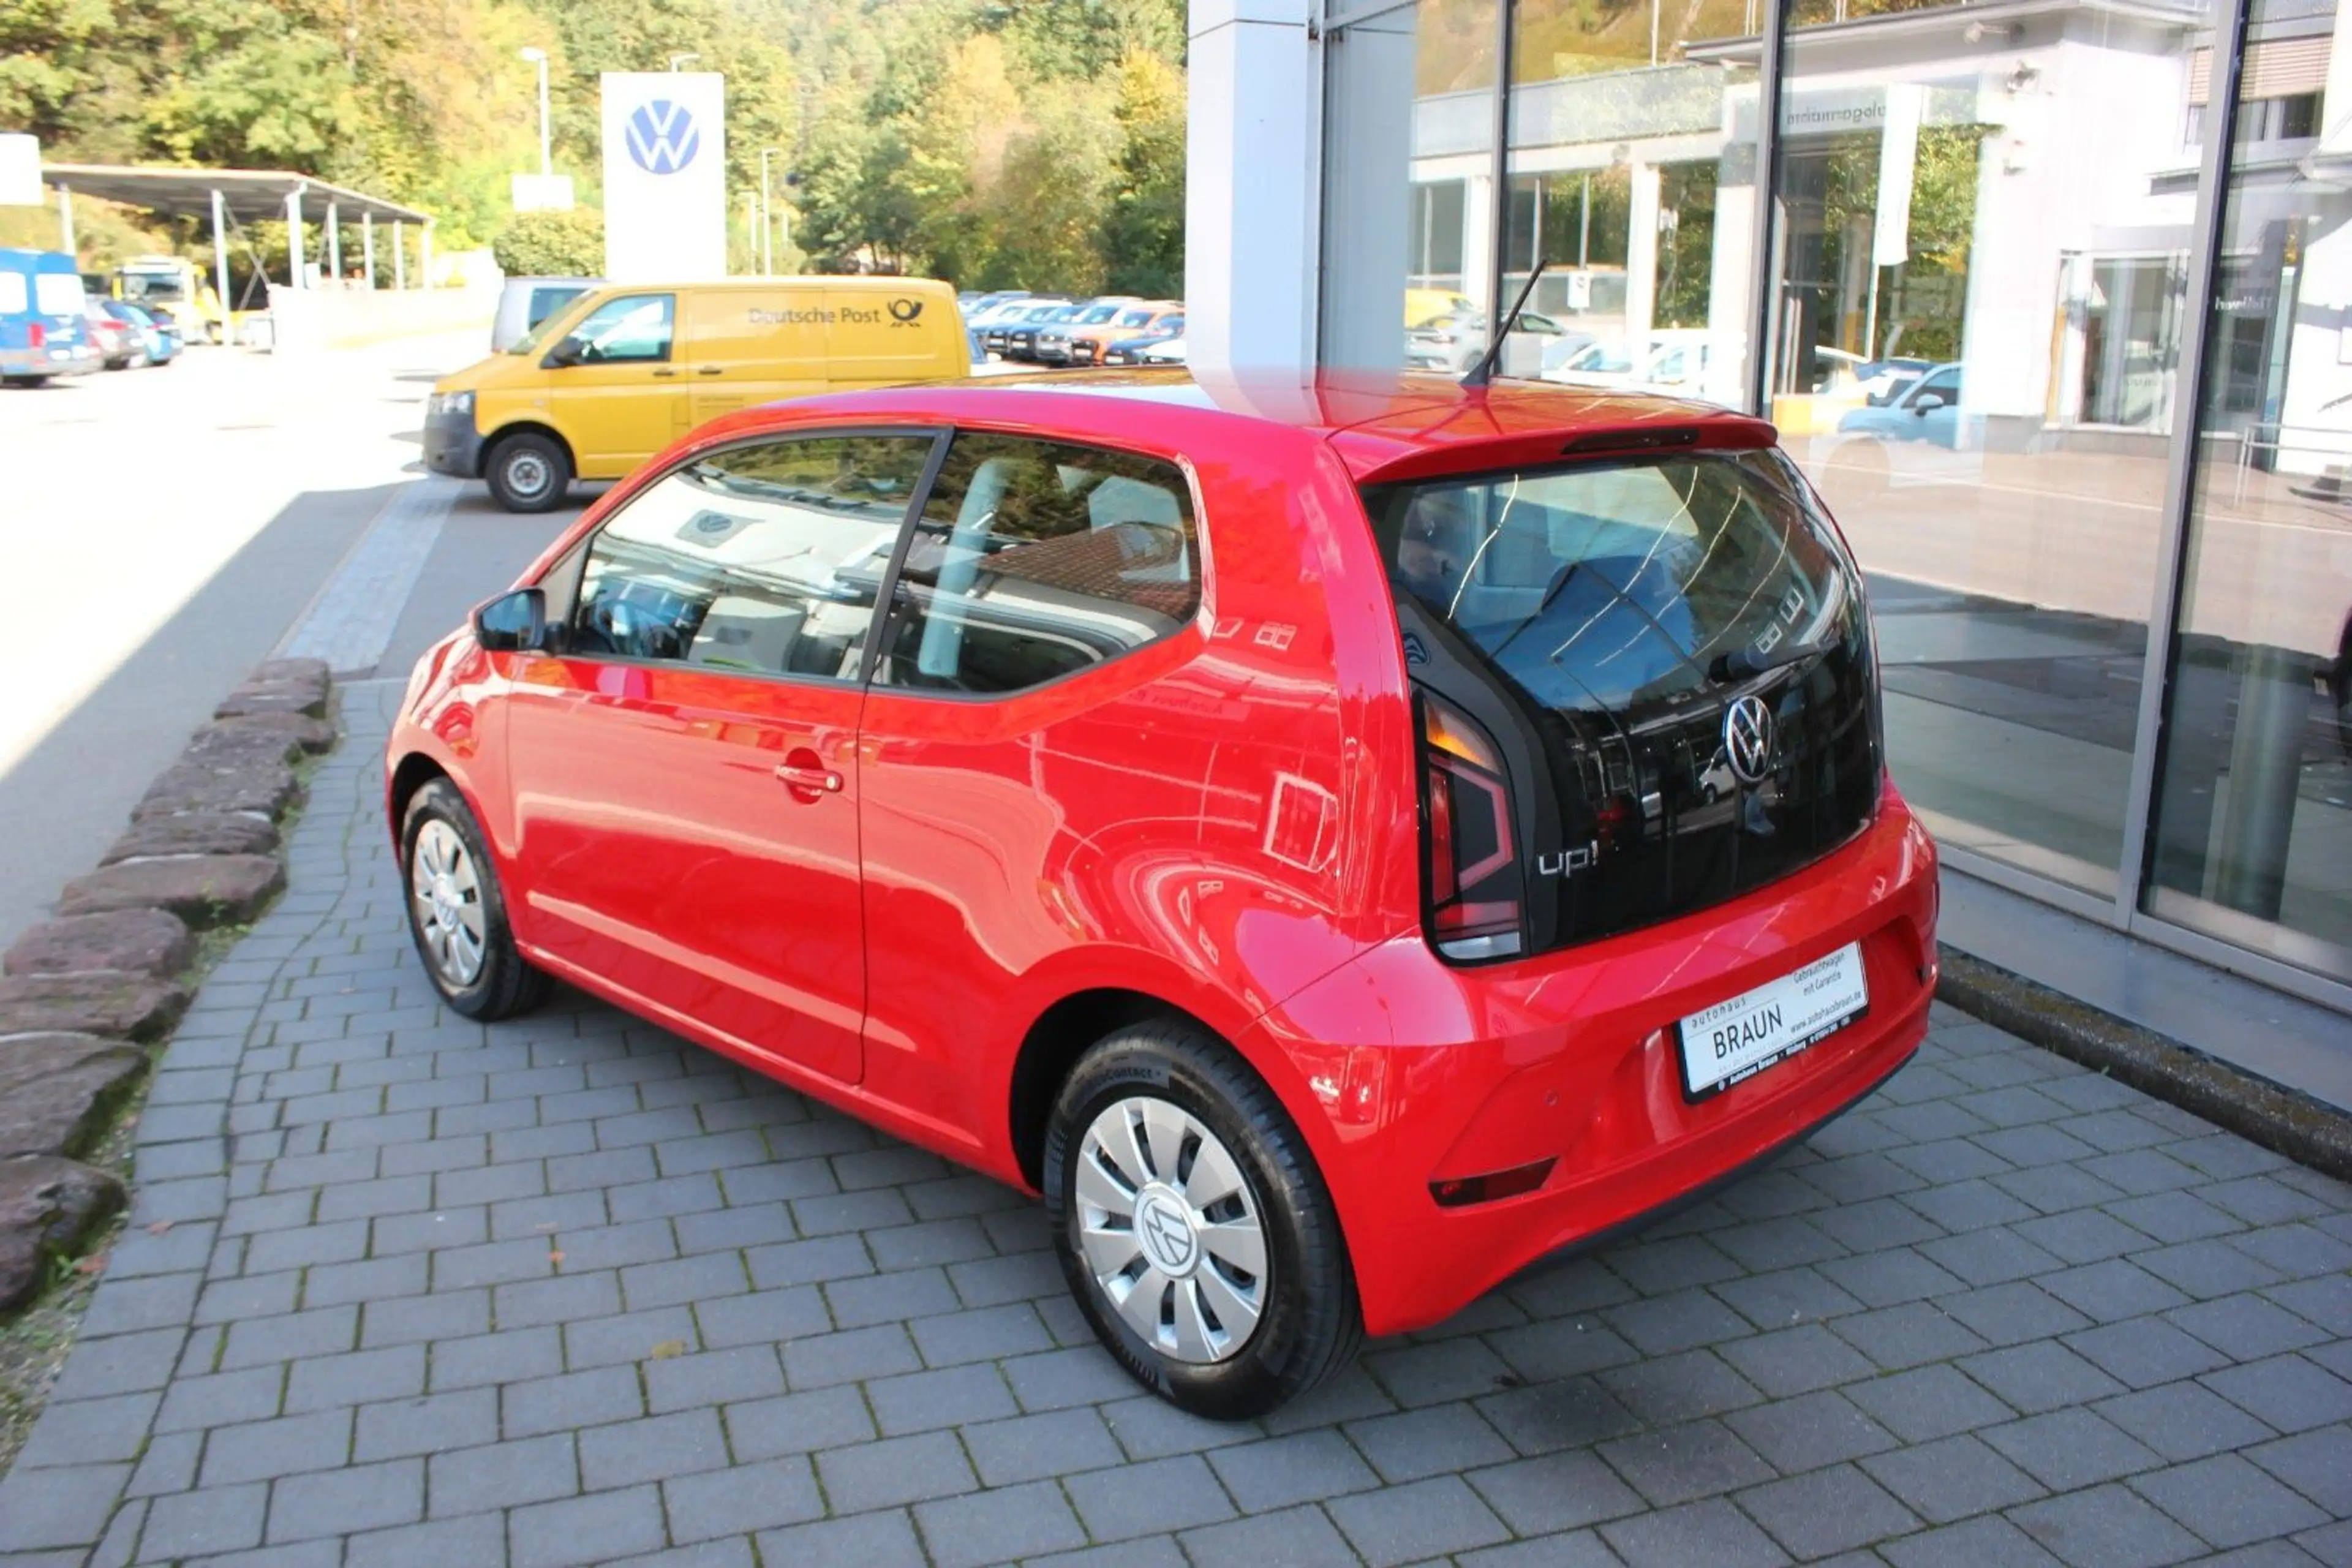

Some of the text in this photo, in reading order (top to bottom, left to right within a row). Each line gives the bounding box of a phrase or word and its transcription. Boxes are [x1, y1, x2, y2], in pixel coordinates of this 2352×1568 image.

[748, 307, 881, 324] Deutsche Post
[1539, 839, 1598, 878] up!
[1714, 1003, 1782, 1060] BRAUN
